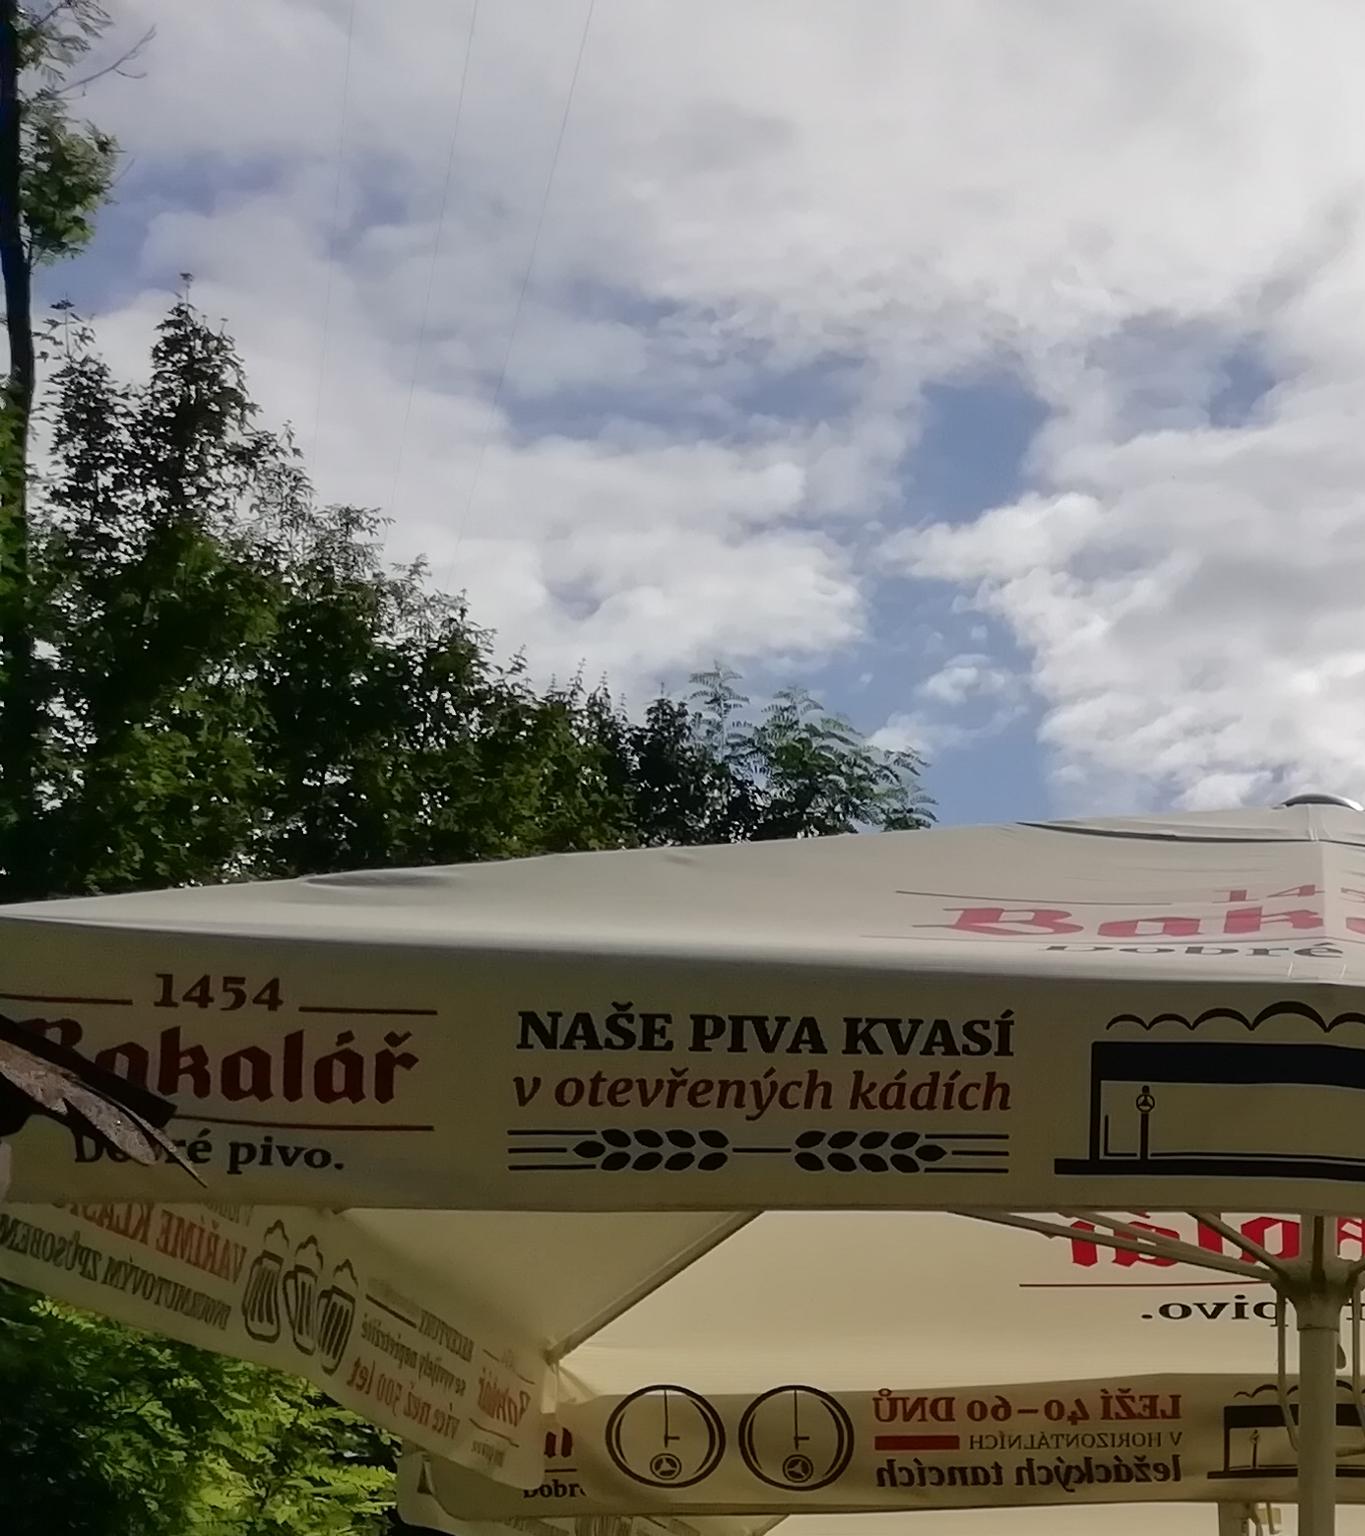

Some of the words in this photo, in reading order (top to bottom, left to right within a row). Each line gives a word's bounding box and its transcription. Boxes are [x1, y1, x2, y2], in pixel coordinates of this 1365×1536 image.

[153, 972, 284, 1011] 1454
[516, 1001, 674, 1052] NAŠE
[688, 1012, 829, 1055] PIVA
[842, 1008, 1016, 1057] KVASÍ
[513, 1075, 541, 1107] v
[553, 1067, 833, 1122] otevřených
[848, 1067, 1012, 1112] kádích
[226, 1136, 345, 1175] pivo.
